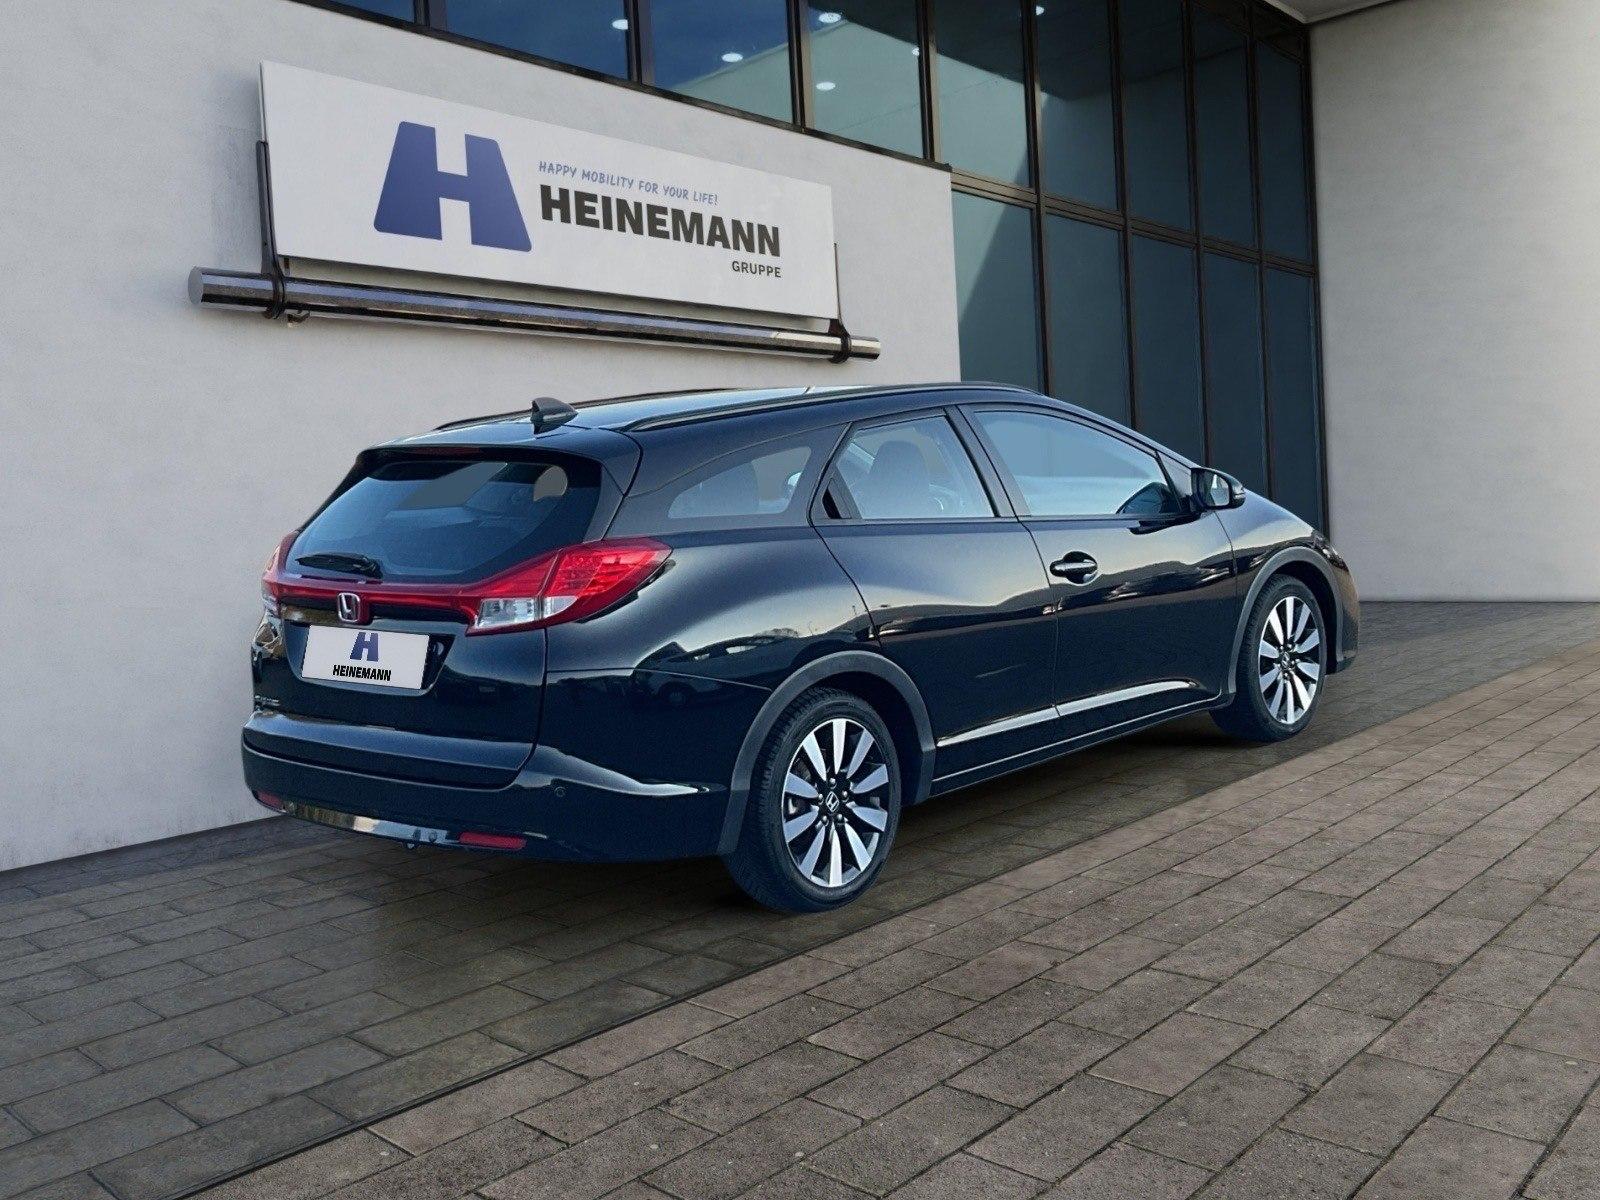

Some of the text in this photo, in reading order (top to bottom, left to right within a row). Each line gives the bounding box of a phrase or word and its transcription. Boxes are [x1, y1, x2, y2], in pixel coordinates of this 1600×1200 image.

[373, 121, 532, 252] H
[538, 160, 718, 205] HAPPY MOBILITY FOR YOUR LIFE!
[539, 184, 781, 257] HEINEMANN
[731, 260, 782, 278] GRUPPE
[349, 631, 379, 662] H
[332, 664, 392, 682] HEINEMANN
